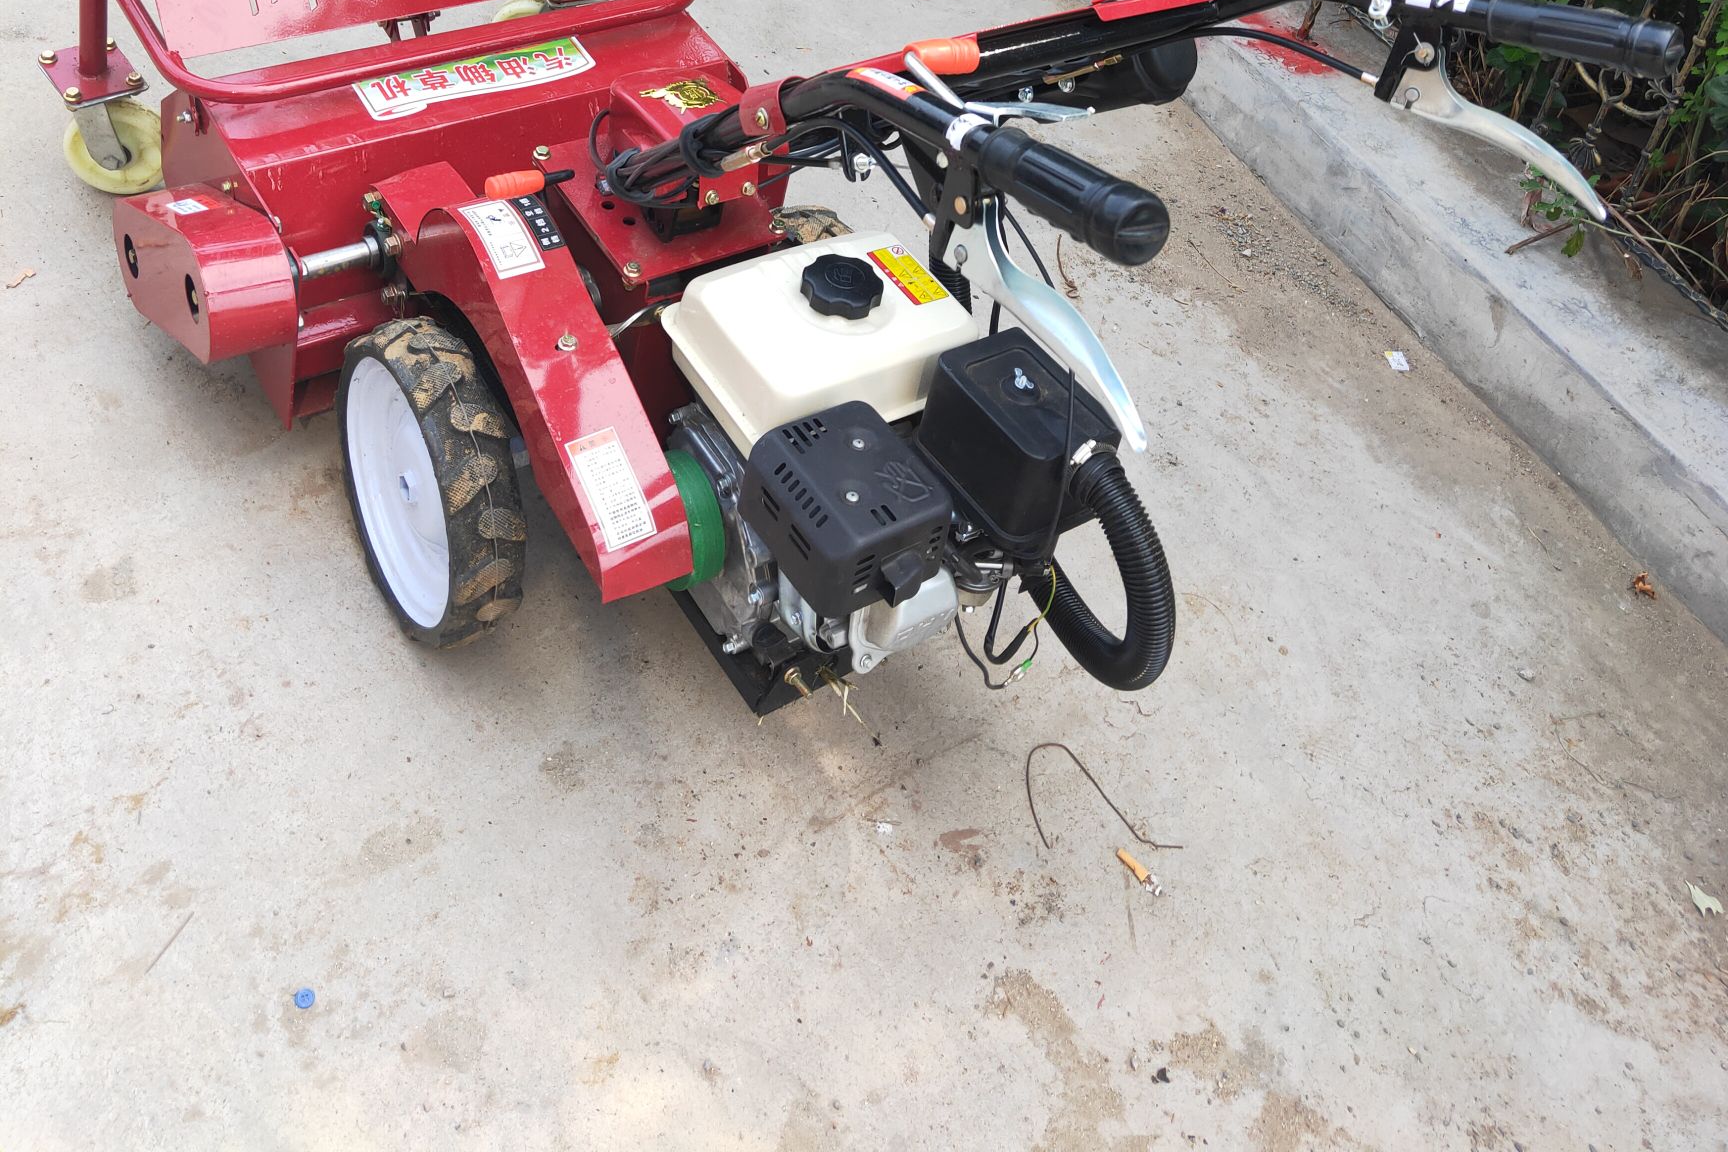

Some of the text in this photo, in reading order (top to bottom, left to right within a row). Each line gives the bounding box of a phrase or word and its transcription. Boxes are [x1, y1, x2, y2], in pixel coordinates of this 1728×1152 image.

[371, 47, 573, 101] 汽油锄草机
